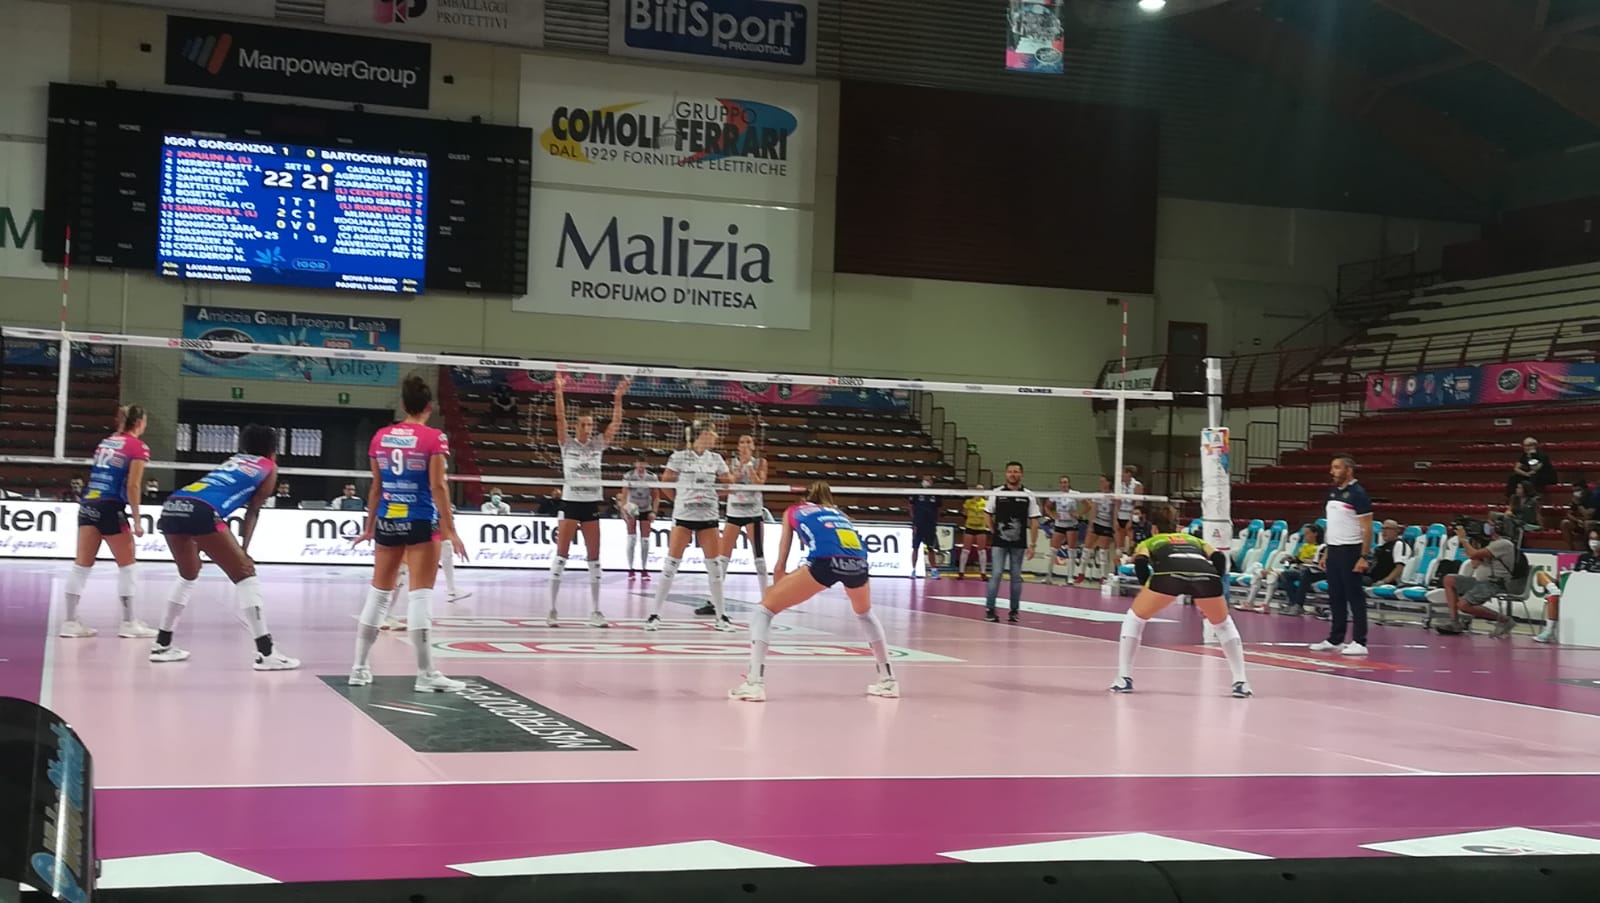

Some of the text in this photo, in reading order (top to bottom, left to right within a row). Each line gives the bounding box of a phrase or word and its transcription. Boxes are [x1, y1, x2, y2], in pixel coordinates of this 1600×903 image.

[437, 11, 508, 29] PROTETTIVI
[239, 47, 417, 87] ManpowerGroup
[675, 101, 758, 125] GRUPPO
[551, 107, 788, 161] COMOLI FERRARI
[320, 150, 392, 164] BARTOCCINI
[393, 156, 428, 168] FORTI
[550, 143, 787, 176] DAL 1929 FORNITURE ELETTRICHE
[264, 170, 293, 188] 22
[301, 173, 329, 191] 21
[555, 212, 774, 284] Malizia
[571, 281, 758, 310] PROFUMO D'INTESA
[197, 307, 387, 333] Amicizia Gioia Impegno Lealtà
[391, 448, 404, 476] 9
